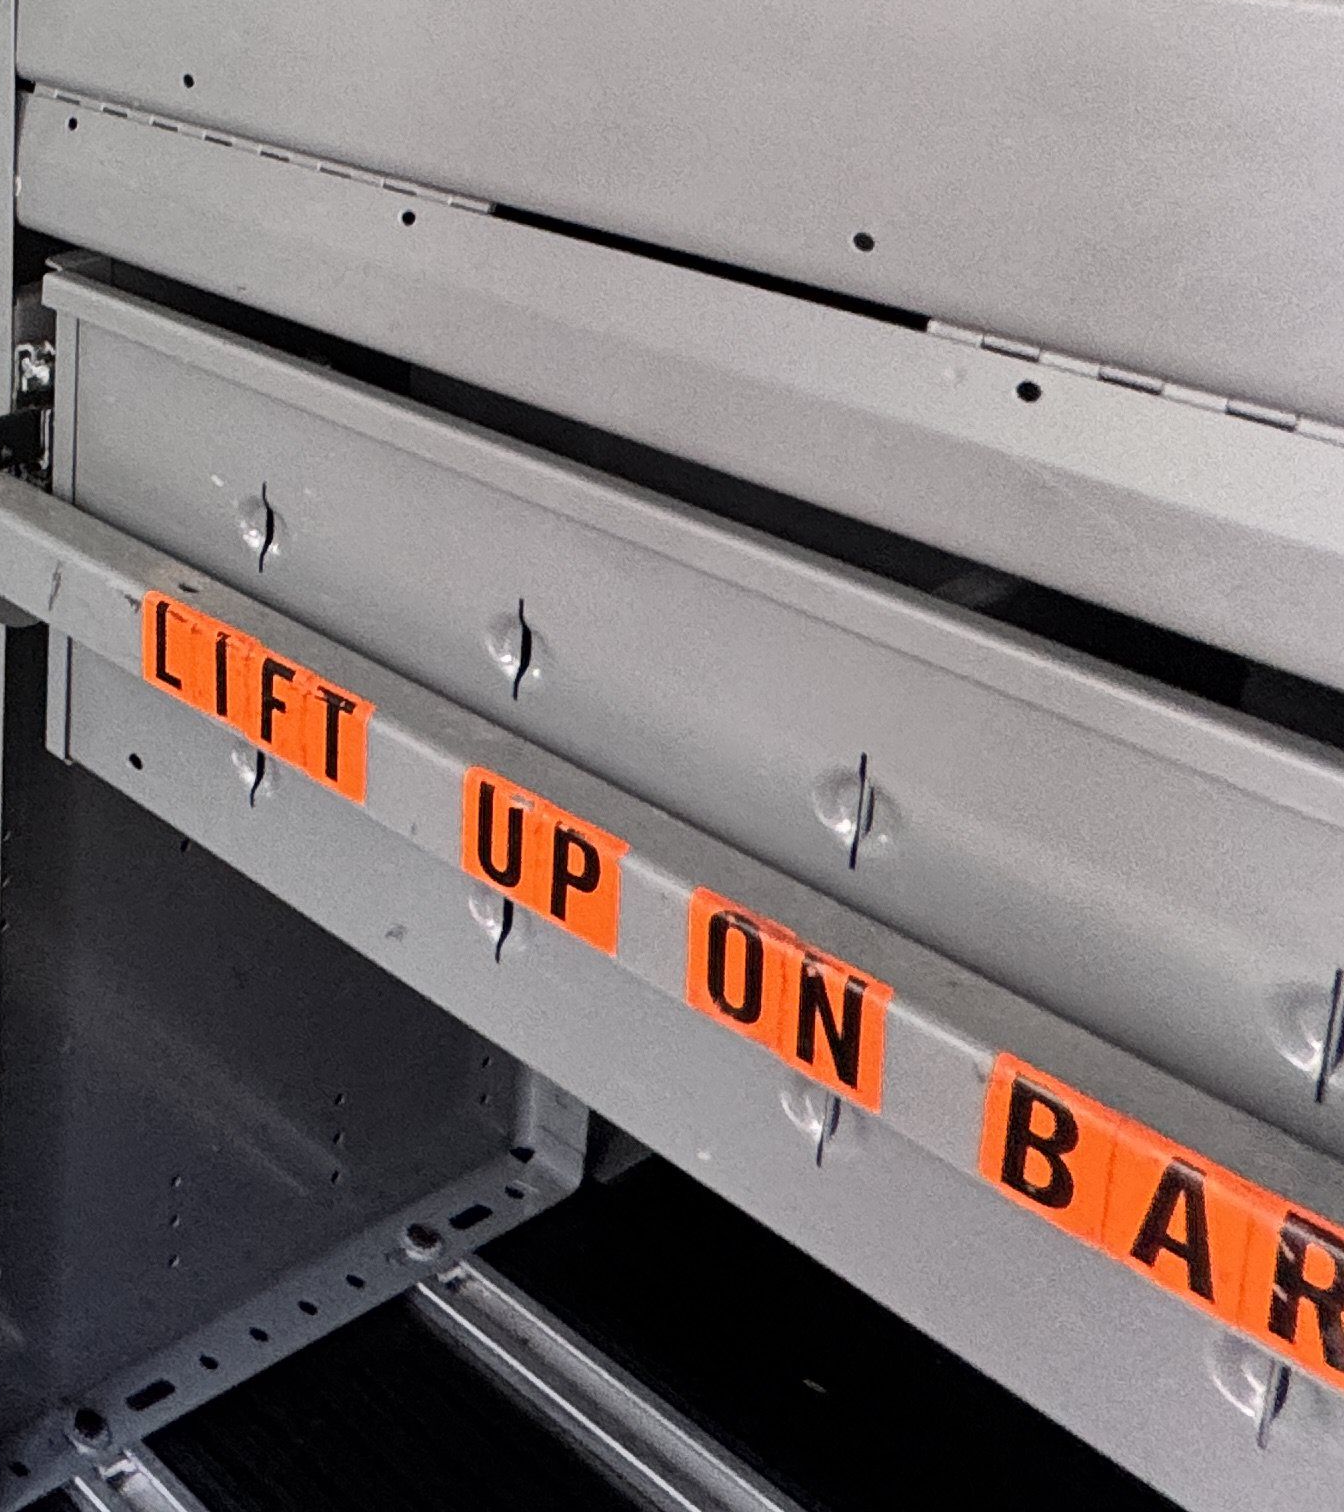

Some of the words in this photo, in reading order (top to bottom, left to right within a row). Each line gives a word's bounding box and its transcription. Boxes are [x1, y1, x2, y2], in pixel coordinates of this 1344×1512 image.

[156, 600, 356, 782] LIFT
[477, 780, 601, 921] UP
[707, 909, 868, 1089] ON
[1001, 1072, 1344, 1372] BAR
